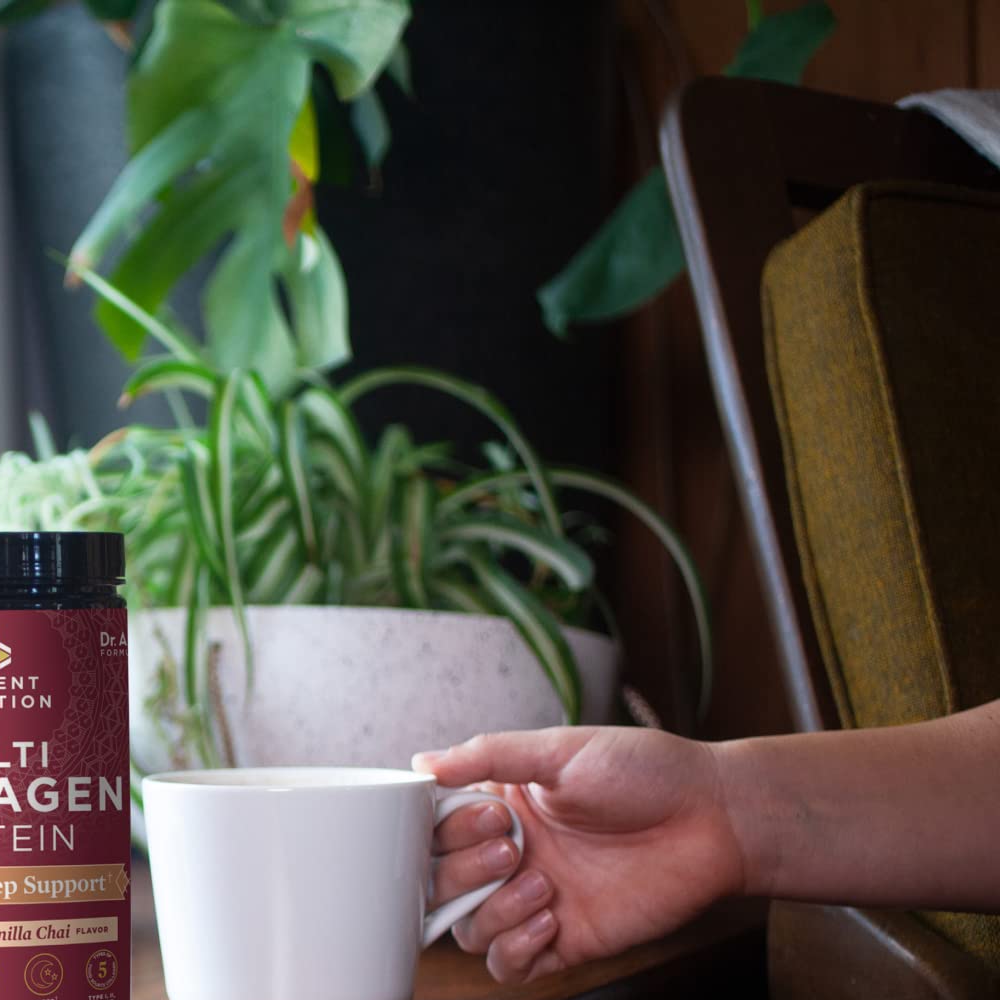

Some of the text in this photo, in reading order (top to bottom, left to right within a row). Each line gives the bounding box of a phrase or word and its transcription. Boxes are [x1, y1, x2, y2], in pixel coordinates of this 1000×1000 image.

[100, 631, 117, 647] Dr.
[36, 924, 71, 940] Chai
[76, 926, 109, 935] FLAVOR
[98, 961, 107, 978] 5
